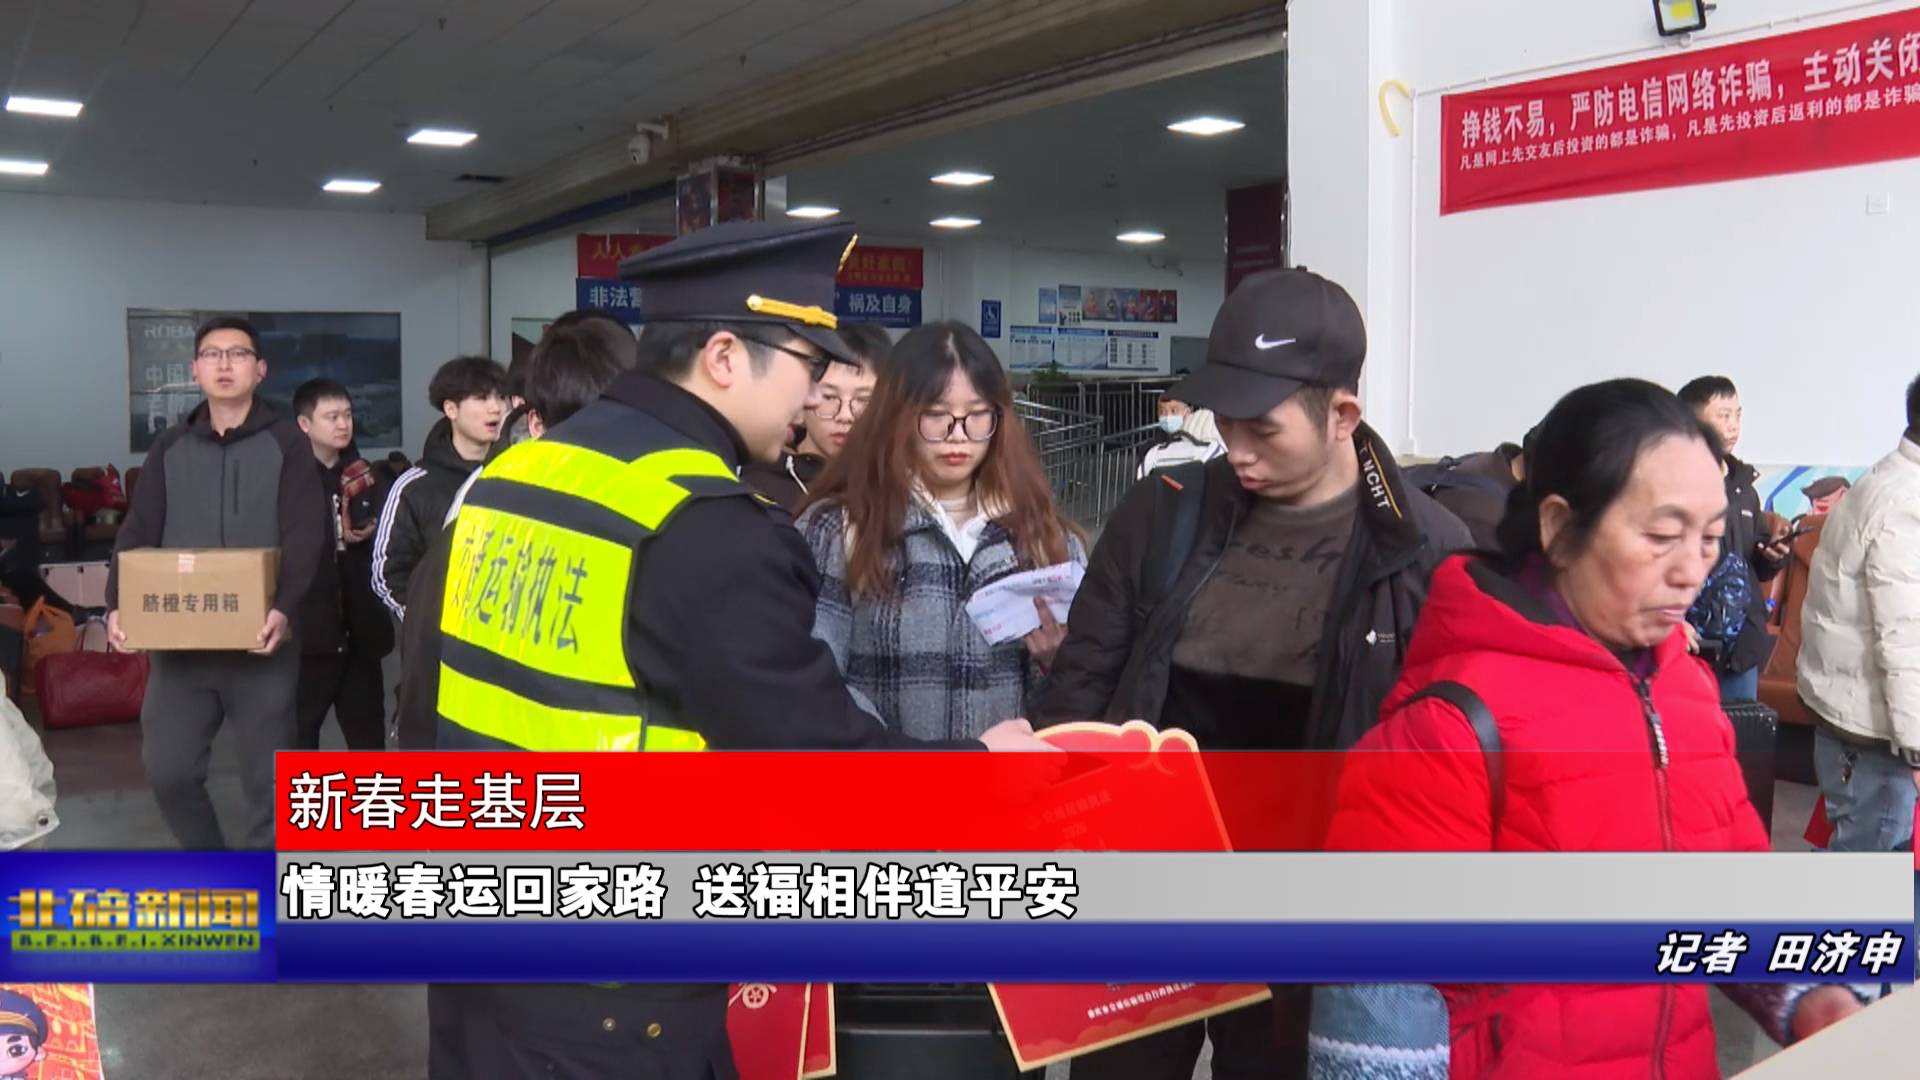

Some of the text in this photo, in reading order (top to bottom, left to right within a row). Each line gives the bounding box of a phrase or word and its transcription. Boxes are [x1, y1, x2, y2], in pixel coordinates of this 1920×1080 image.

[142, 592, 239, 613] 脐橙专用箱
